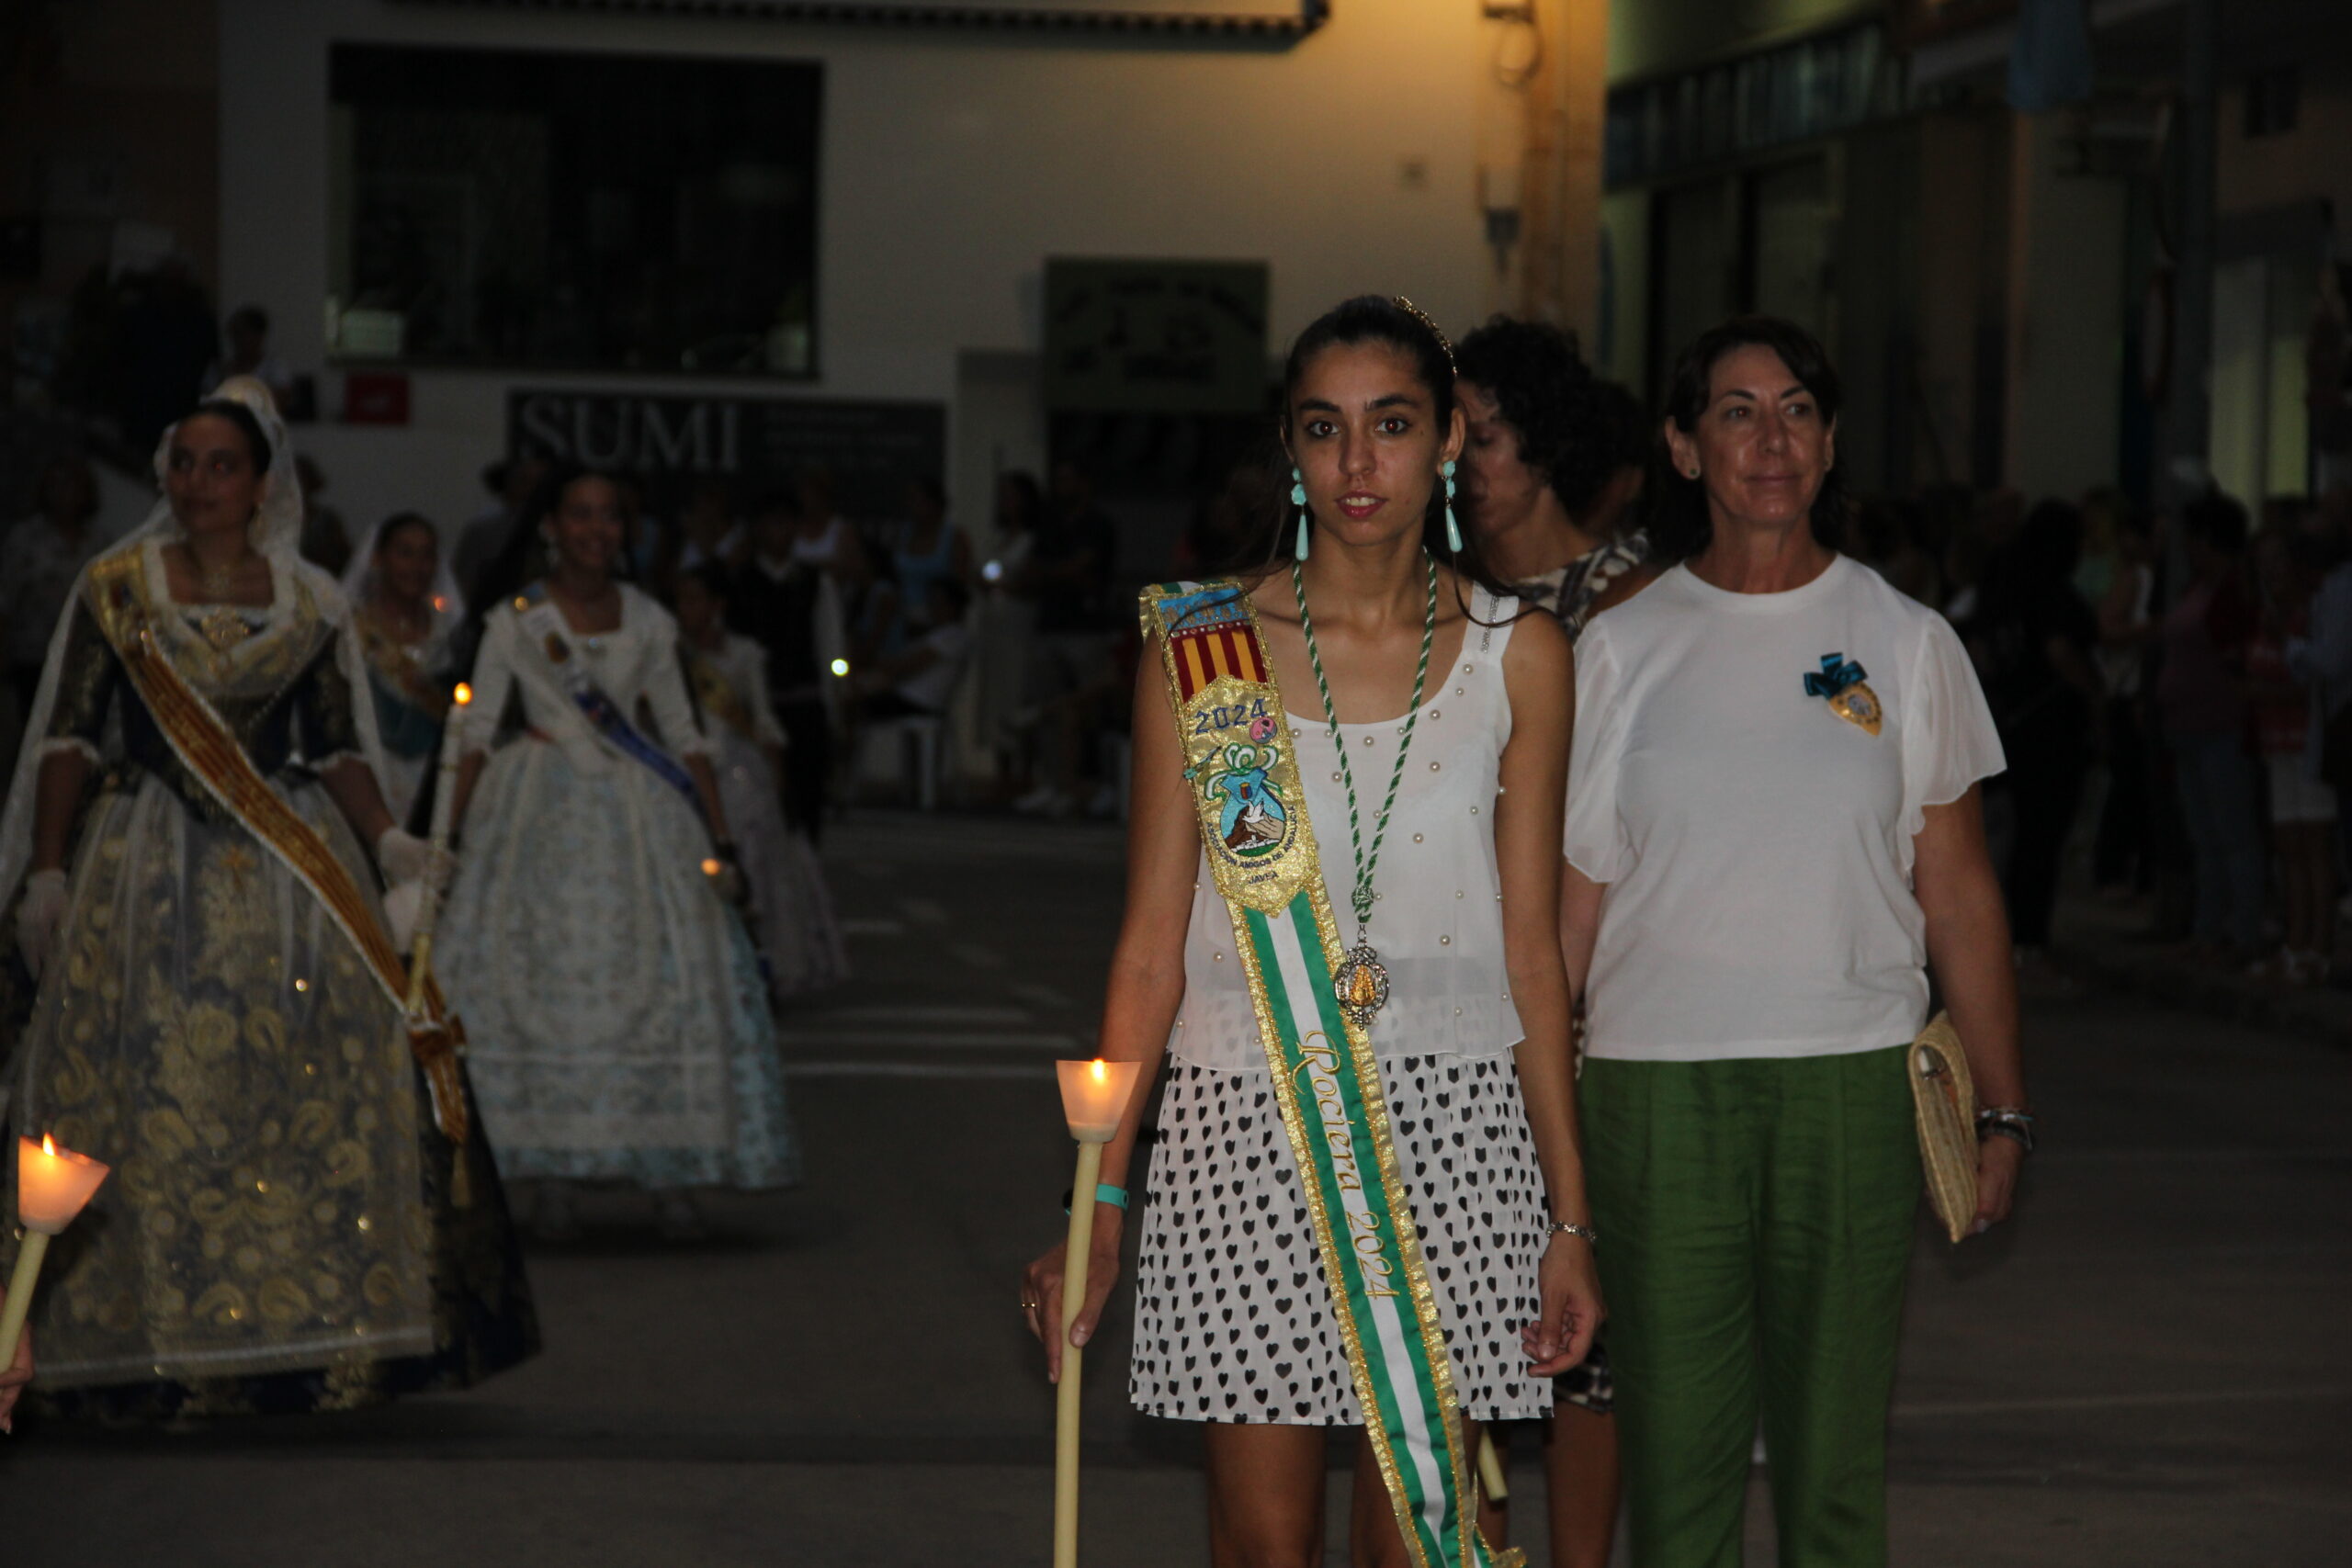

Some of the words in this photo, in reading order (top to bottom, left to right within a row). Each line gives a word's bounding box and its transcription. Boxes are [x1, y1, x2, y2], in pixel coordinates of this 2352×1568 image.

[519, 393, 742, 472] SUMI
[1195, 699, 1267, 734] 2024
[1239, 858, 1272, 869] AMIGOS
[1272, 851, 1284, 862] DE
[1292, 1030, 1362, 1193] Rociera
[1345, 1211, 1401, 1300] 2024
